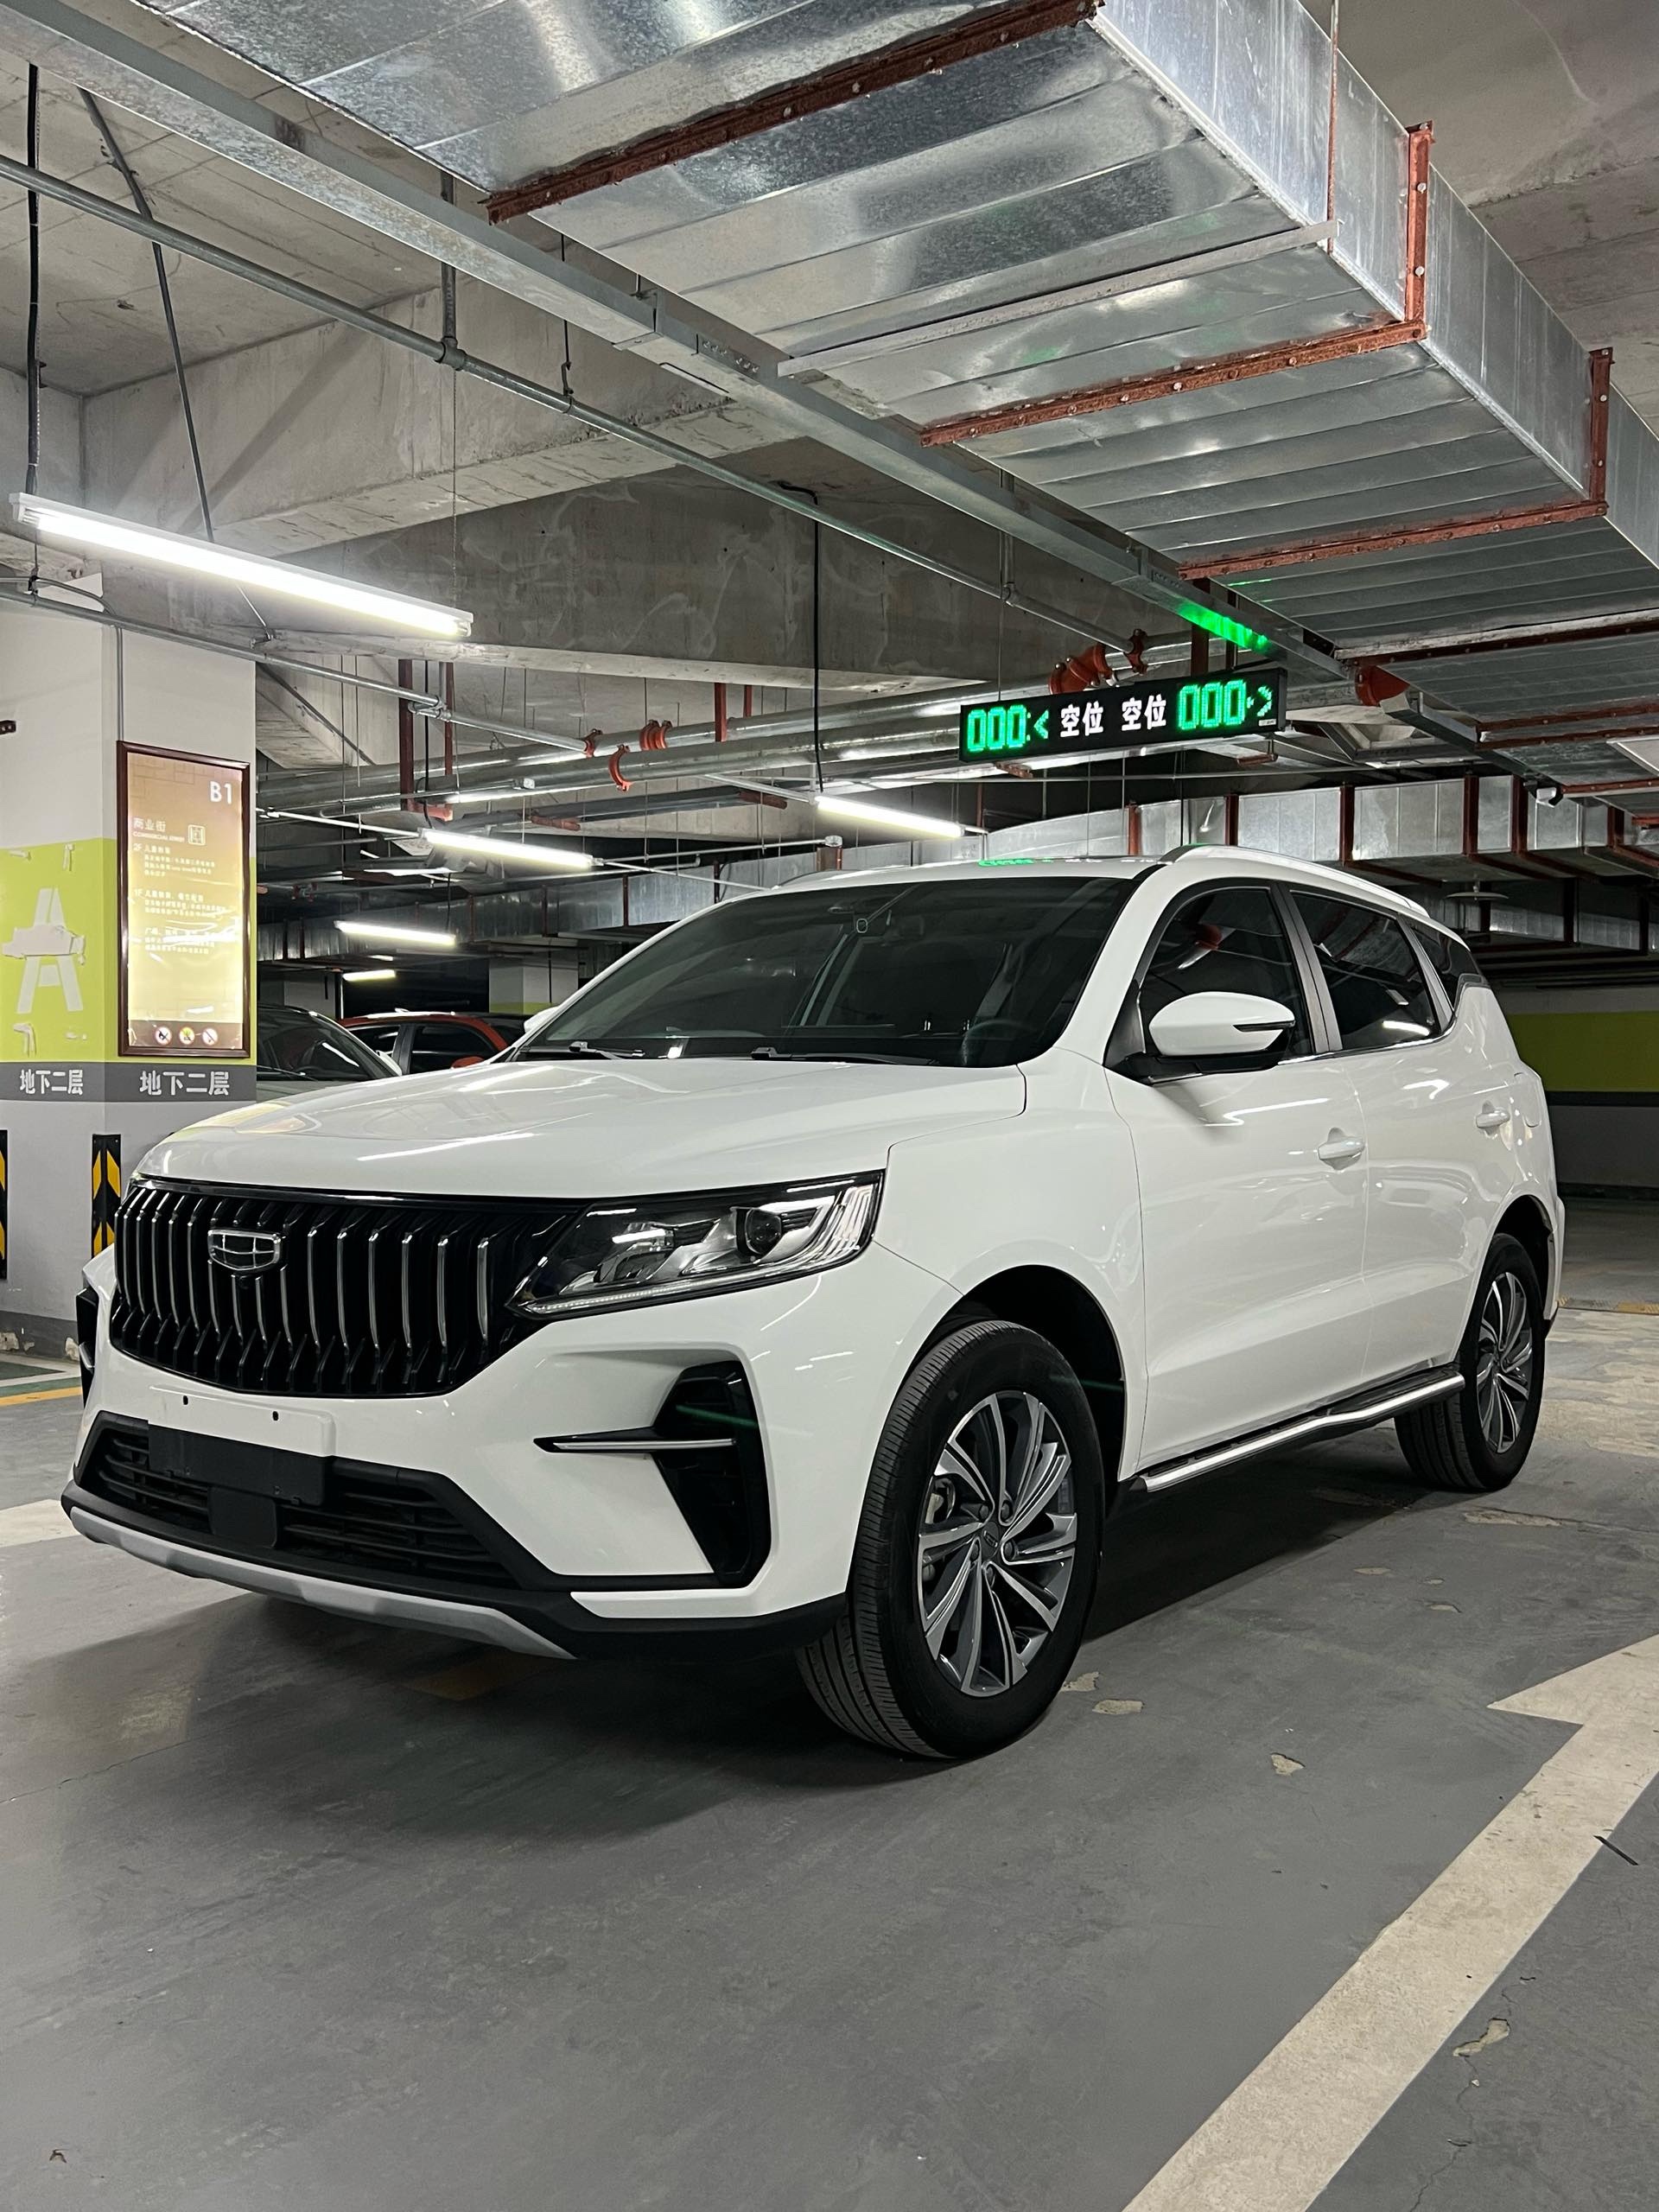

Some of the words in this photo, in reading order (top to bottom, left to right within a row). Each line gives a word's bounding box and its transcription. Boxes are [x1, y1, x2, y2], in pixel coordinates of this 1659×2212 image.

[1060, 701, 1103, 737] 空位
[1122, 693, 1166, 731] 空位
[1178, 679, 1246, 730] 000
[966, 704, 1027, 753] 000
[210, 780, 232, 804] B1
[133, 817, 166, 832] 商业街
[20, 1069, 83, 1096] 地下二层
[139, 1070, 230, 1096] 地下二层
